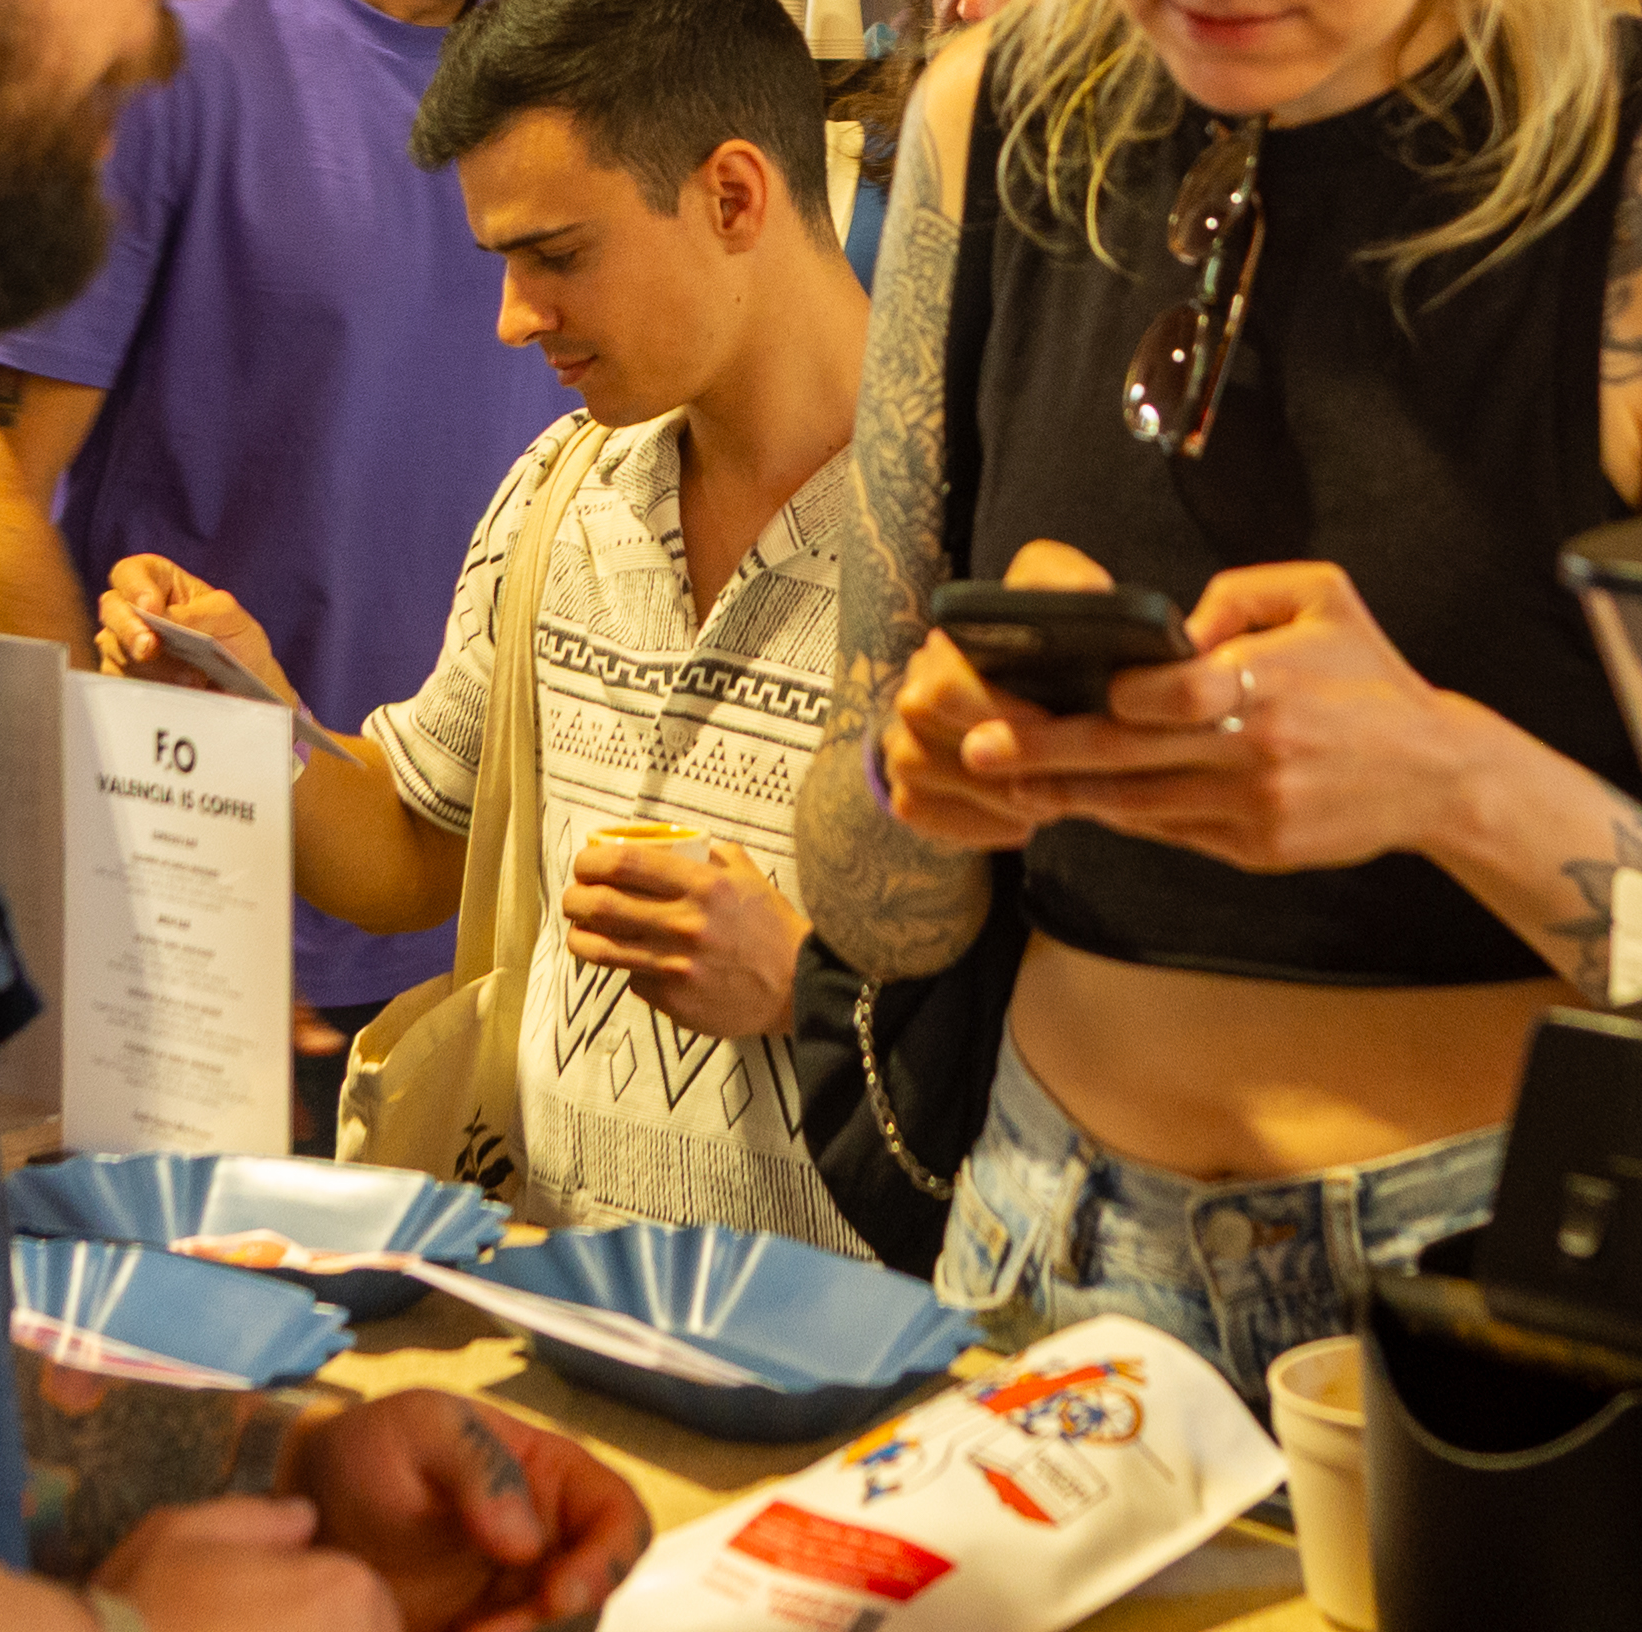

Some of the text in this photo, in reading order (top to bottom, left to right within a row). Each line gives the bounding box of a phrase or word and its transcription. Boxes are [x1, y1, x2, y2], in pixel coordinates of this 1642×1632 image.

[96, 772, 256, 823] VALENCIA IS COFFEE
